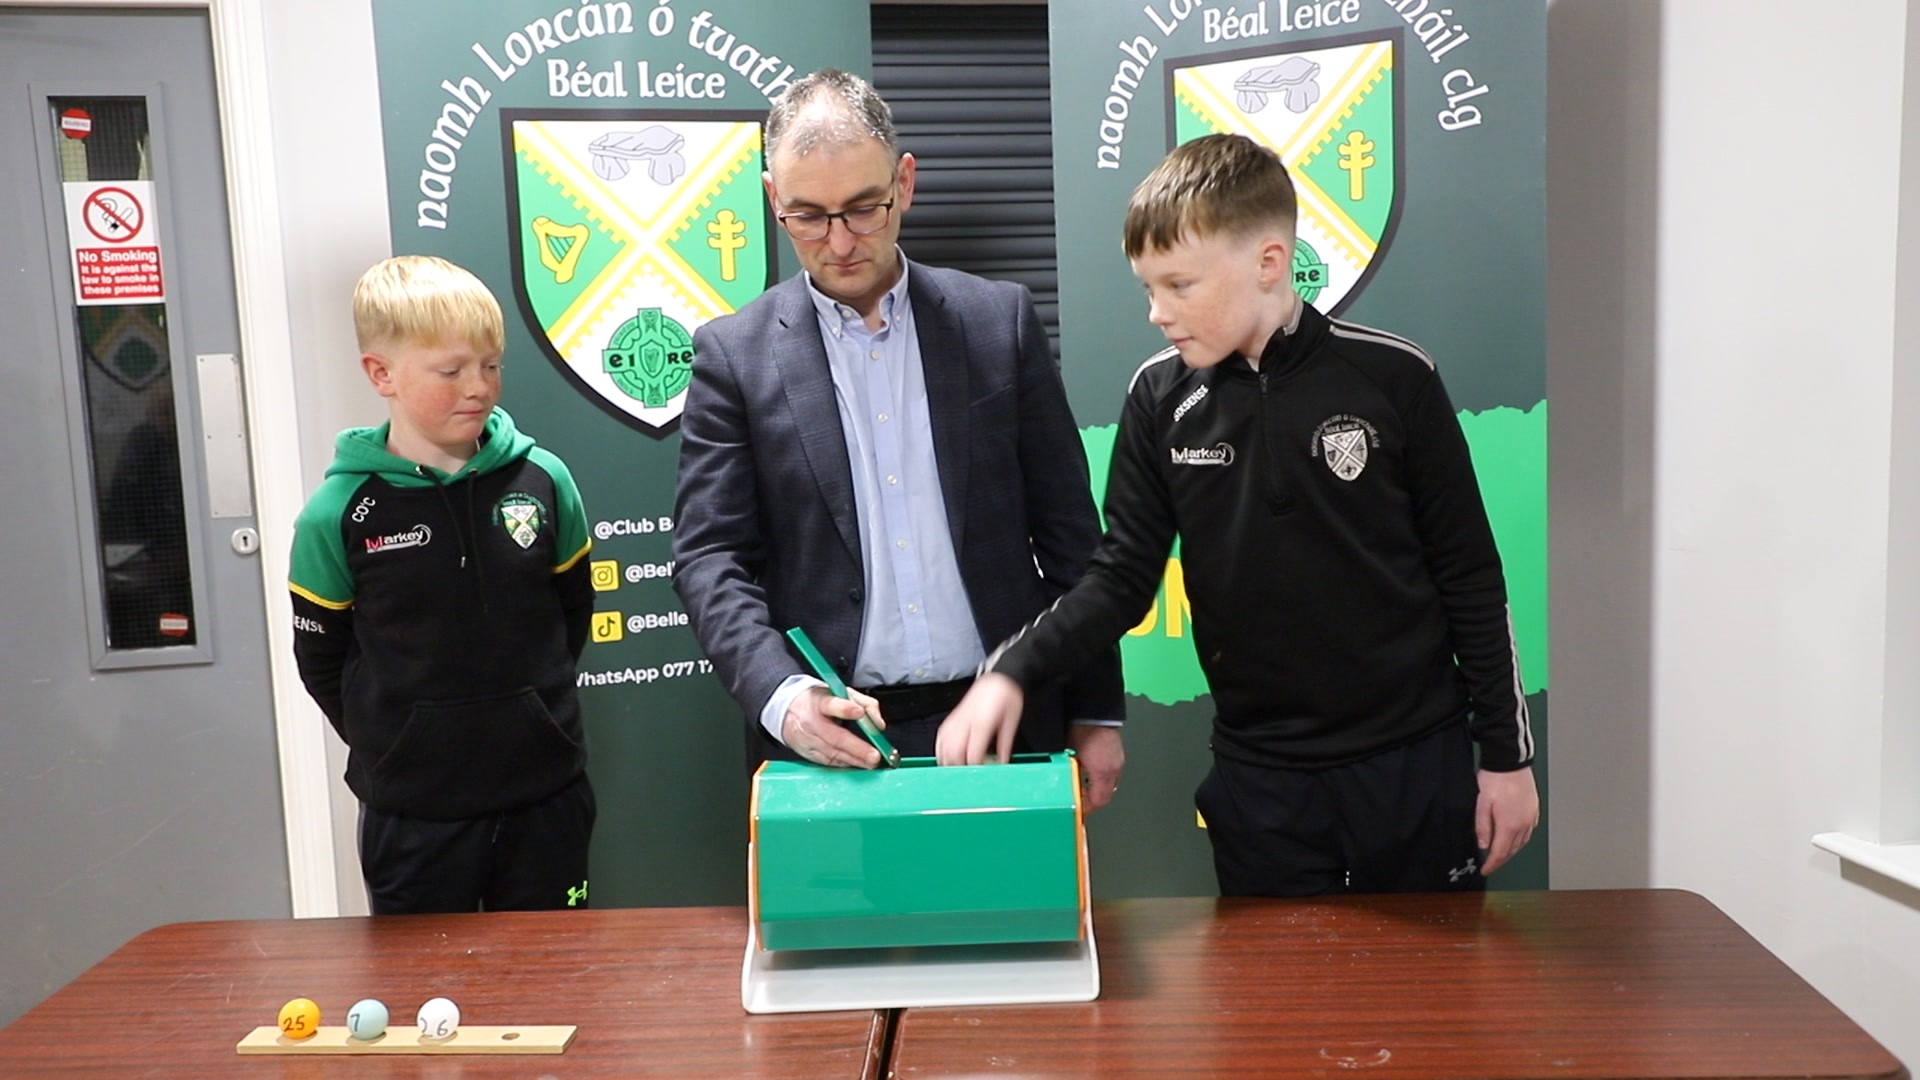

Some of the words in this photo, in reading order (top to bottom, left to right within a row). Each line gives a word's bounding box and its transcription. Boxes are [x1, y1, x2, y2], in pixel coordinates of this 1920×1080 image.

[1202, 4, 1269, 44] Béal
[546, 58, 629, 99] Béal
[637, 61, 728, 99] Leice
[79, 250, 98, 263] No
[101, 249, 157, 263] Smoking
[91, 264, 101, 274] is
[103, 263, 139, 275] against
[141, 263, 157, 272] the
[82, 275, 99, 284] law
[101, 275, 112, 284] to
[114, 274, 147, 283] smoke
[149, 273, 159, 282] in
[84, 285, 112, 295] these
[114, 284, 159, 296] premises
[1170, 446, 1228, 464] Markey
[594, 517, 655, 540] @Club
[658, 516, 675, 532] B
[365, 529, 425, 553] Markey
[626, 610, 689, 634] @Belle
[662, 660, 695, 678] 077
[283, 1014, 306, 1032] 25
